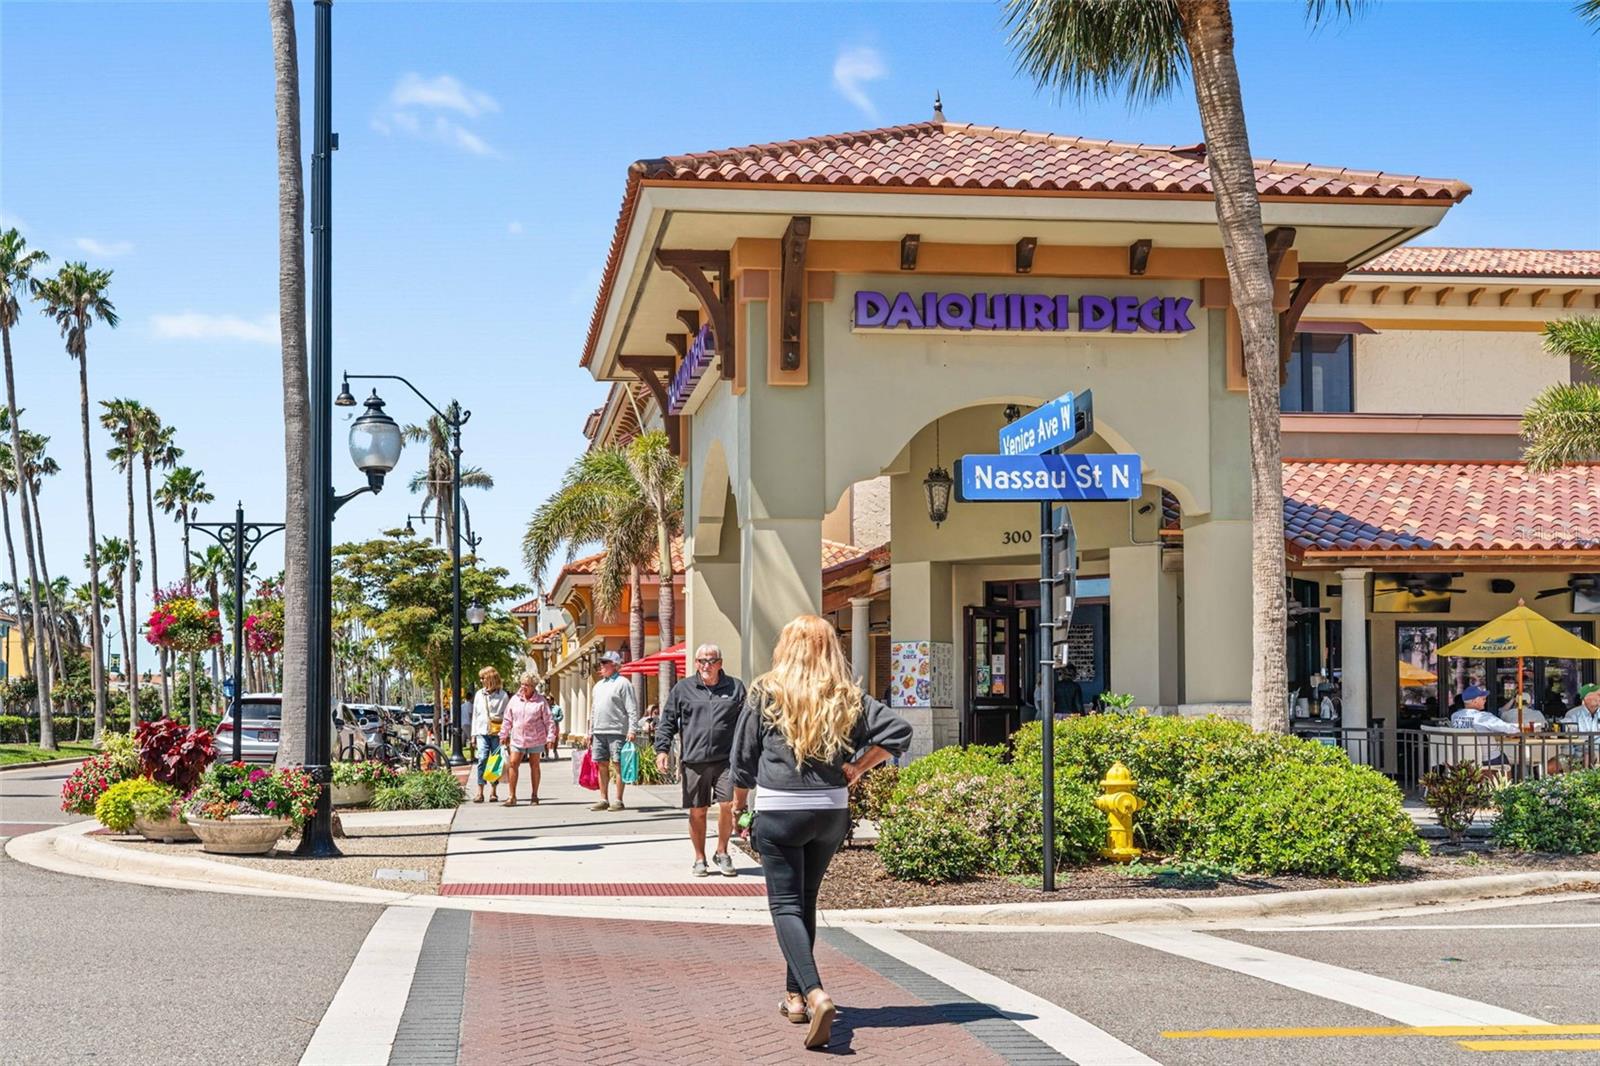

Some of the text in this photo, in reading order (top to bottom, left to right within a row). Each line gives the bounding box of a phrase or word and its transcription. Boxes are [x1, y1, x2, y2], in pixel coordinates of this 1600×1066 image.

[854, 291, 1195, 333] DAIQUIRI DECK
[1002, 404, 1071, 455] Venice Ave W
[975, 464, 1129, 489] Nassau St N
[1002, 530, 1032, 545] 300
